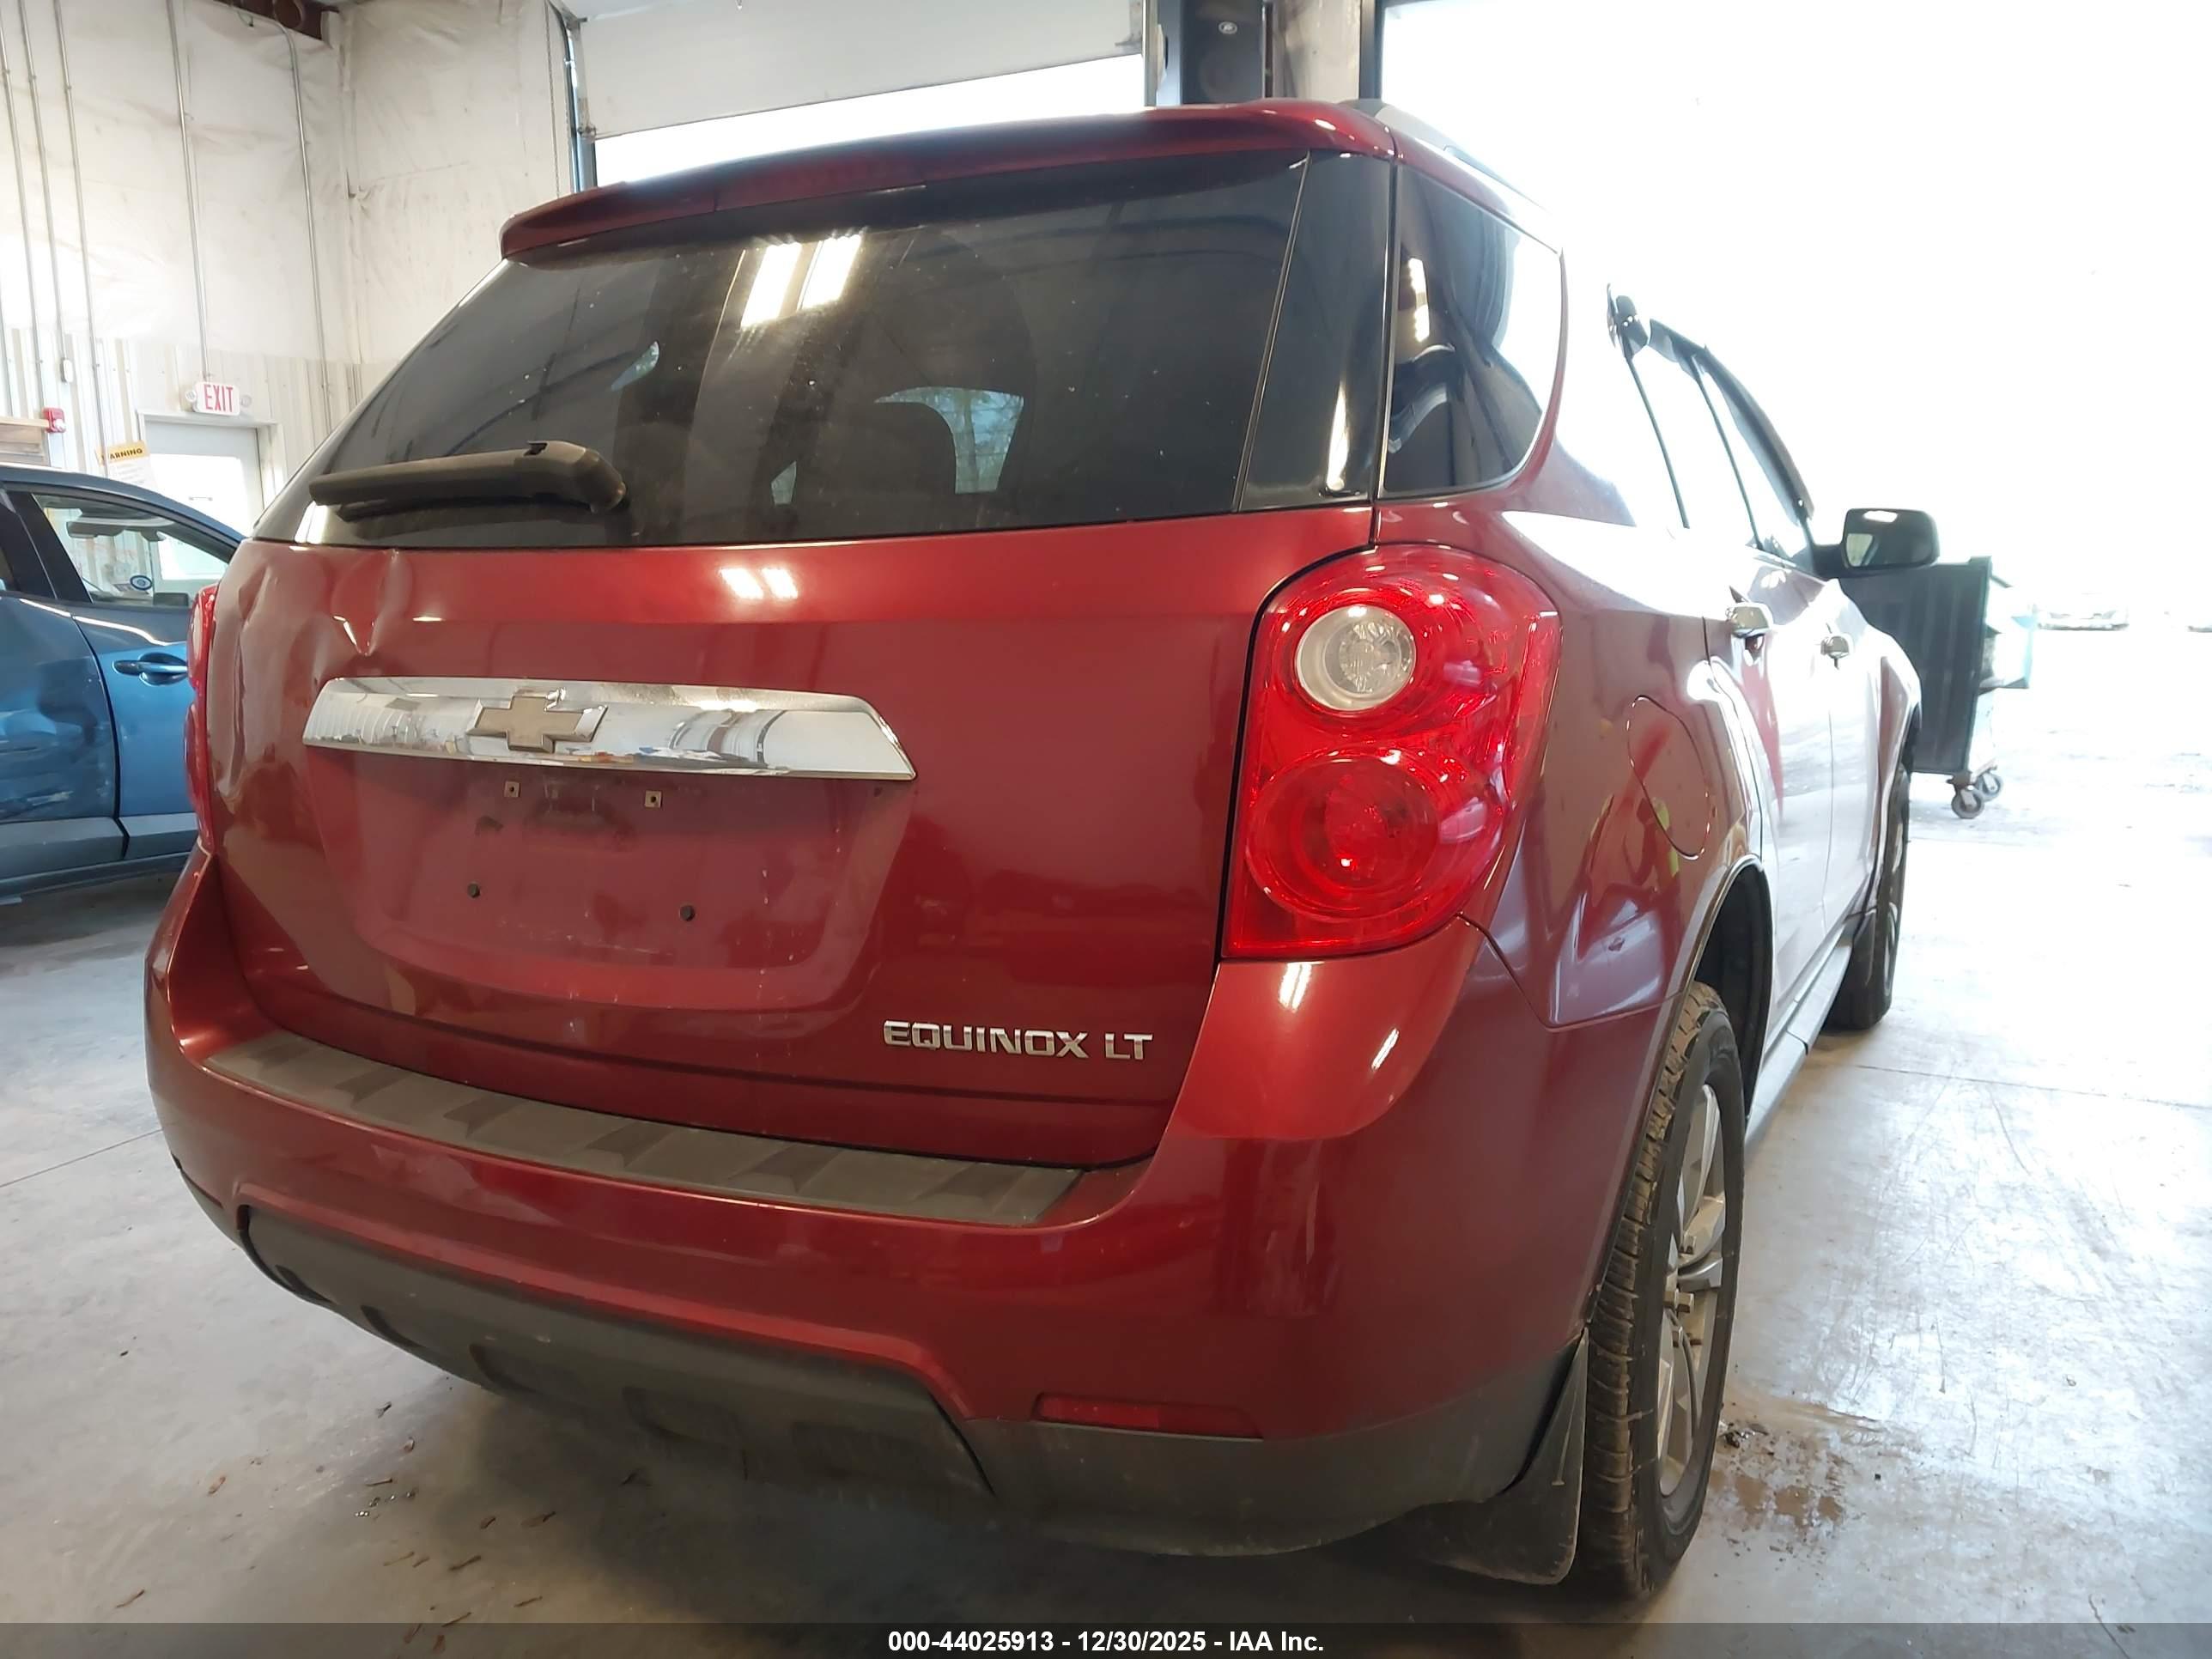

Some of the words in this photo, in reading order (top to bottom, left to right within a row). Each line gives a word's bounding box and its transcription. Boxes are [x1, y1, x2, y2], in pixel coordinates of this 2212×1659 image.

[204, 384, 234, 412] EXIT
[101, 447, 143, 459] ARNING
[884, 1019, 1089, 1059] EQUINOX
[1104, 1032, 1153, 1060] LT
